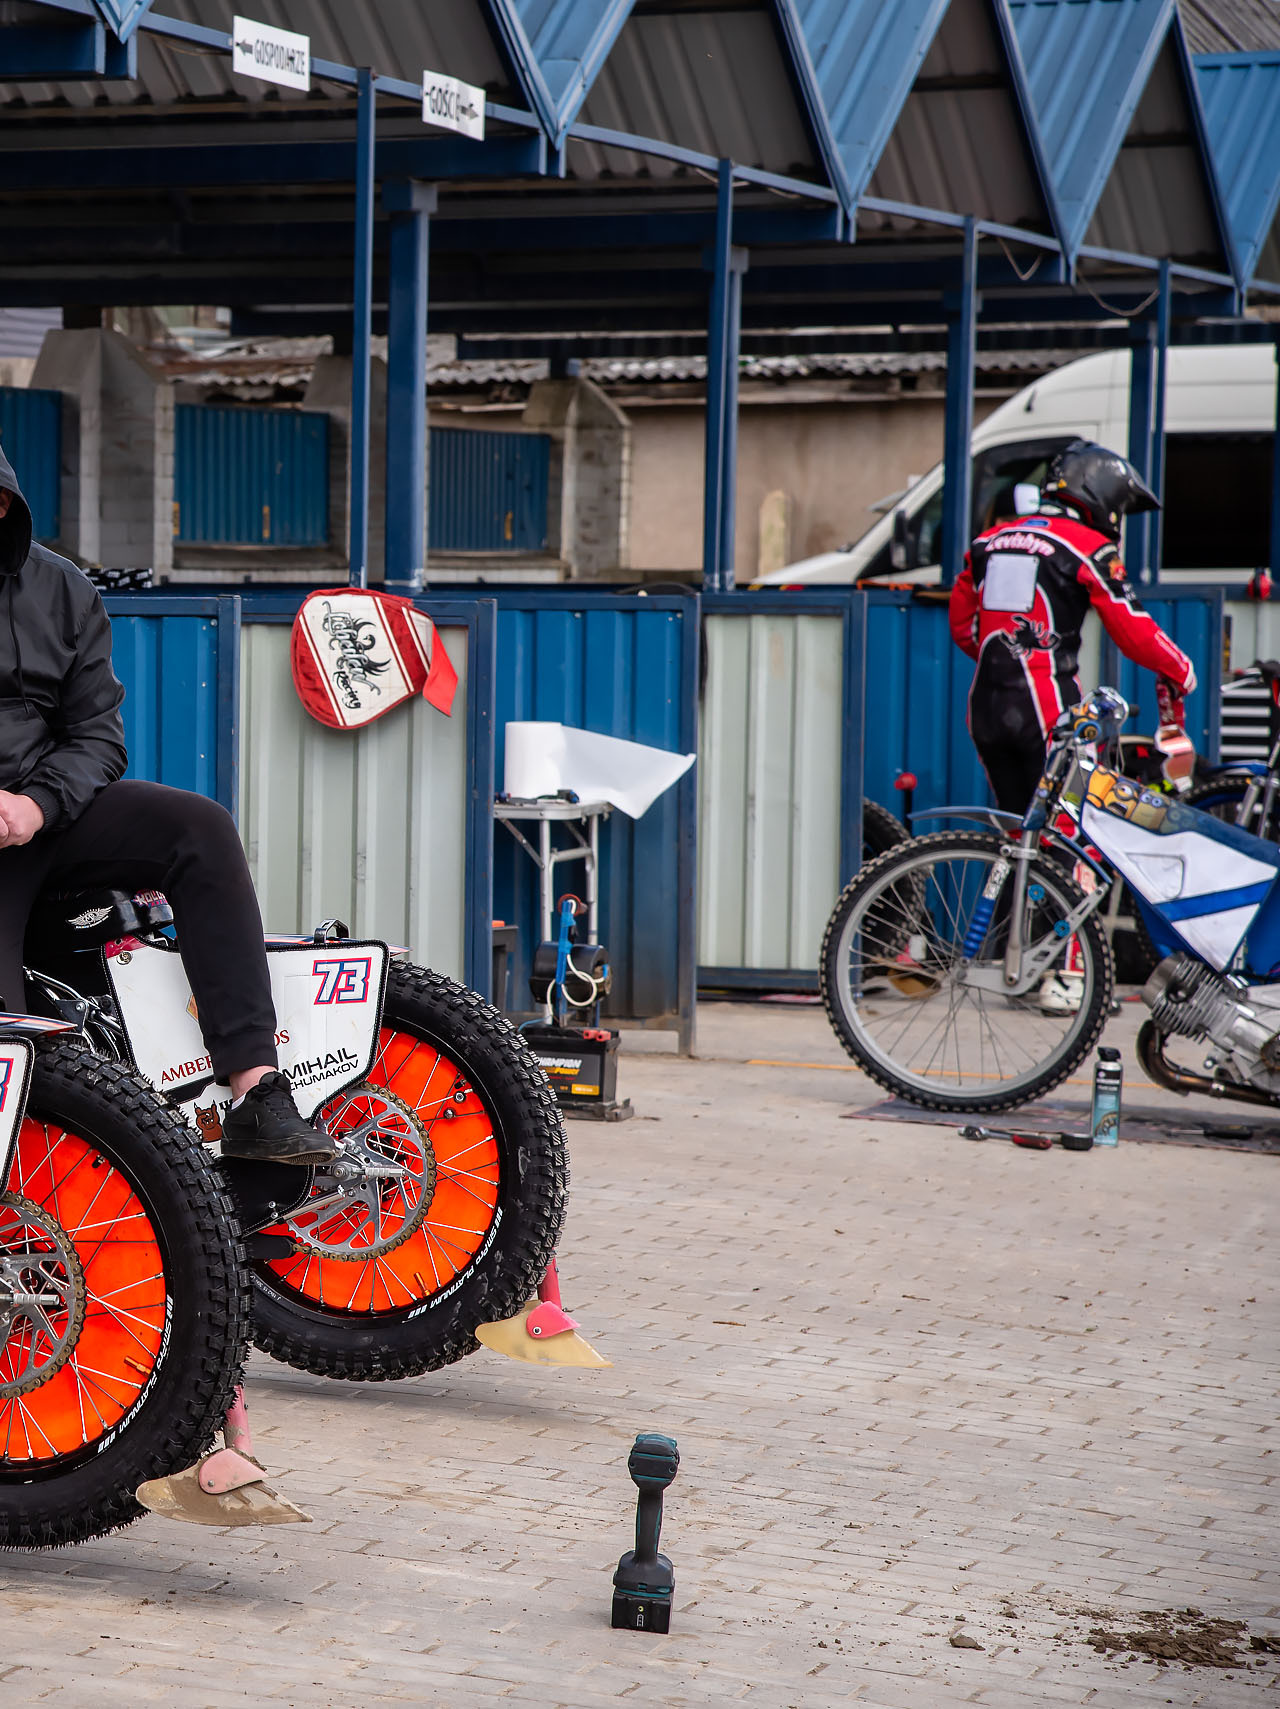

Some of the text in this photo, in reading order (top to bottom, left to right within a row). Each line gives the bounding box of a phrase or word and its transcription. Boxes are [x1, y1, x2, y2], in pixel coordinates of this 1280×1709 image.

[254, 39, 306, 76] GOSPODARZE
[311, 957, 372, 1005] 73
[281, 1047, 358, 1080] MIHAIL
[429, 1265, 475, 1309] PLATINUM
[118, 1371, 158, 1434] PLATINUM
